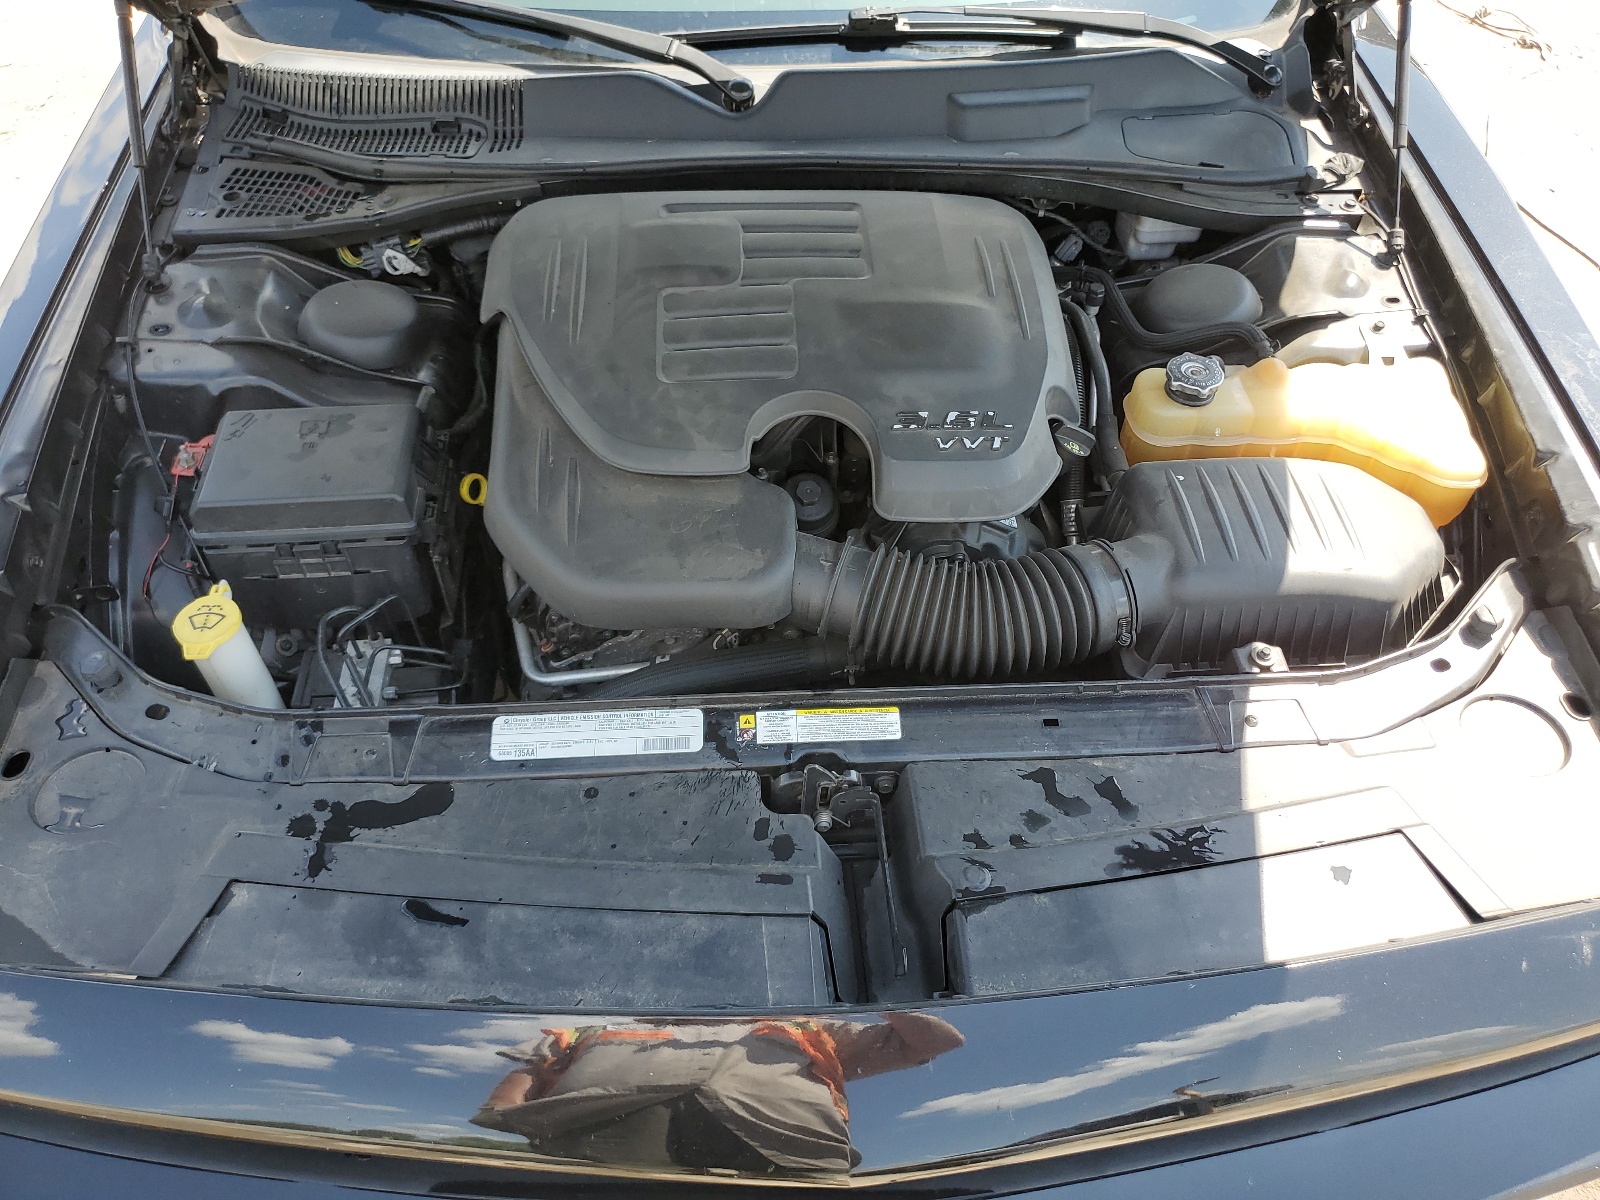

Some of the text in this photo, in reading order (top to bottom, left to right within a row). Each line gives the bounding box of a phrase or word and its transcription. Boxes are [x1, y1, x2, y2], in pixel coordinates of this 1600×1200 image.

[891, 410, 1014, 431] 3.6L
[934, 436, 1010, 452] VVT
[513, 749, 535, 757] 135AA
